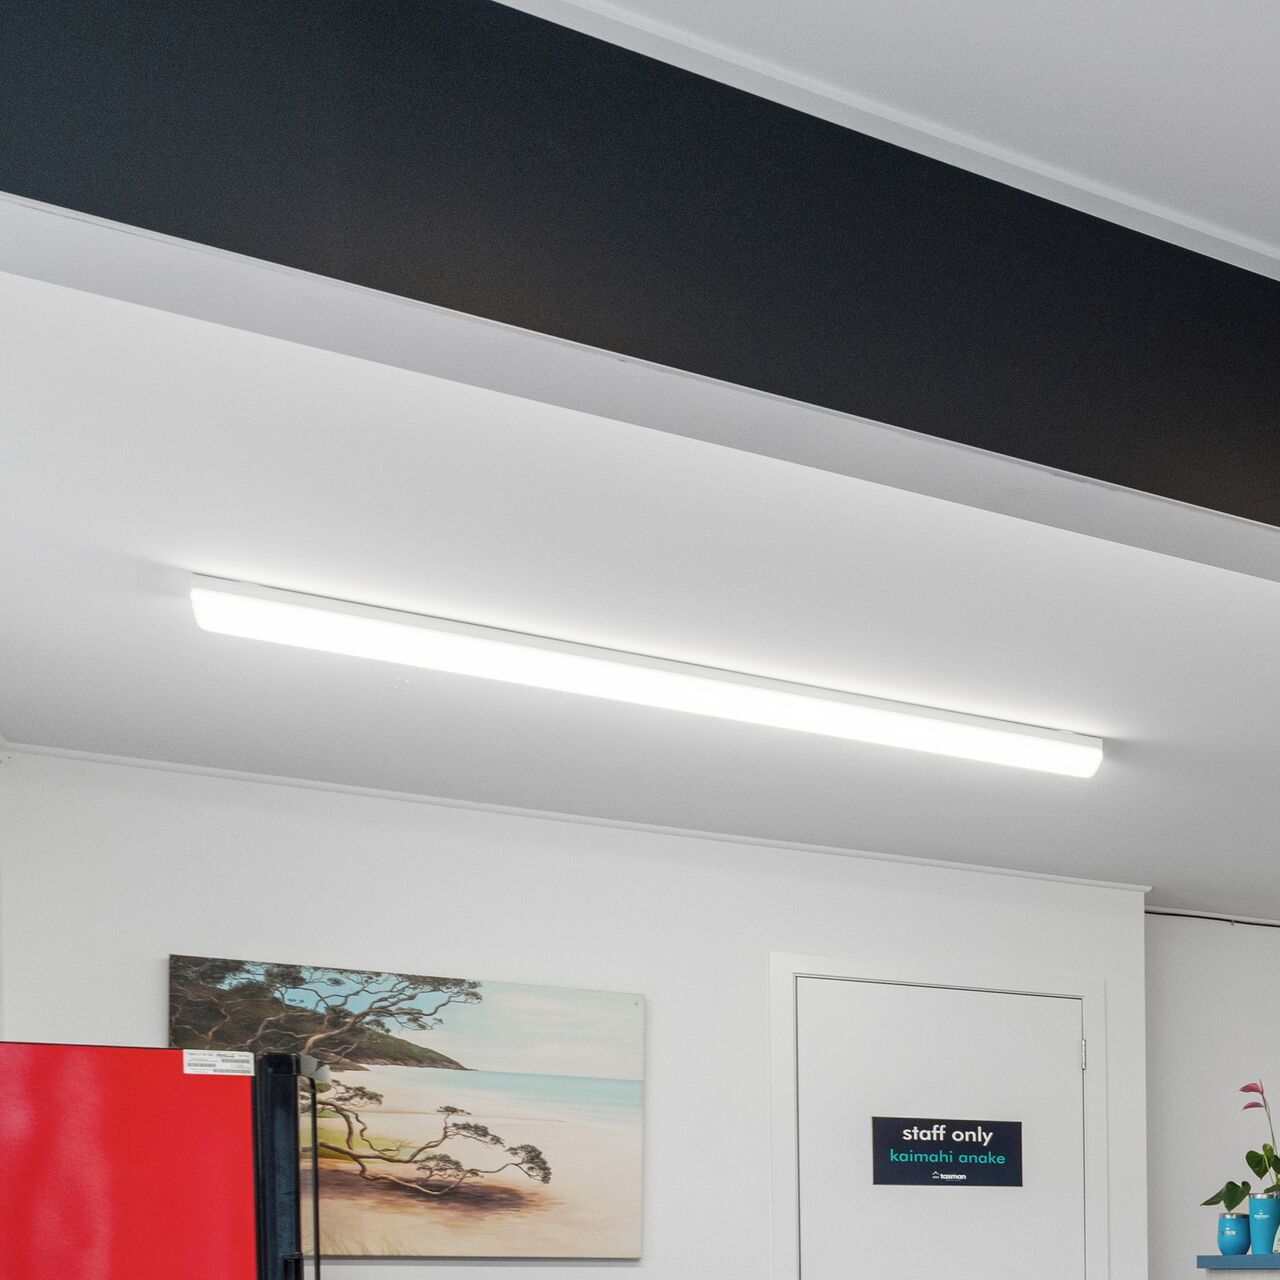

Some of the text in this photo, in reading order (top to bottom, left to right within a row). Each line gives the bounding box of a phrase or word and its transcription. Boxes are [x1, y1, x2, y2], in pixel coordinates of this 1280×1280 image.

[902, 1125, 994, 1147] staff only
[890, 1149, 1006, 1164] kaimahi anake
